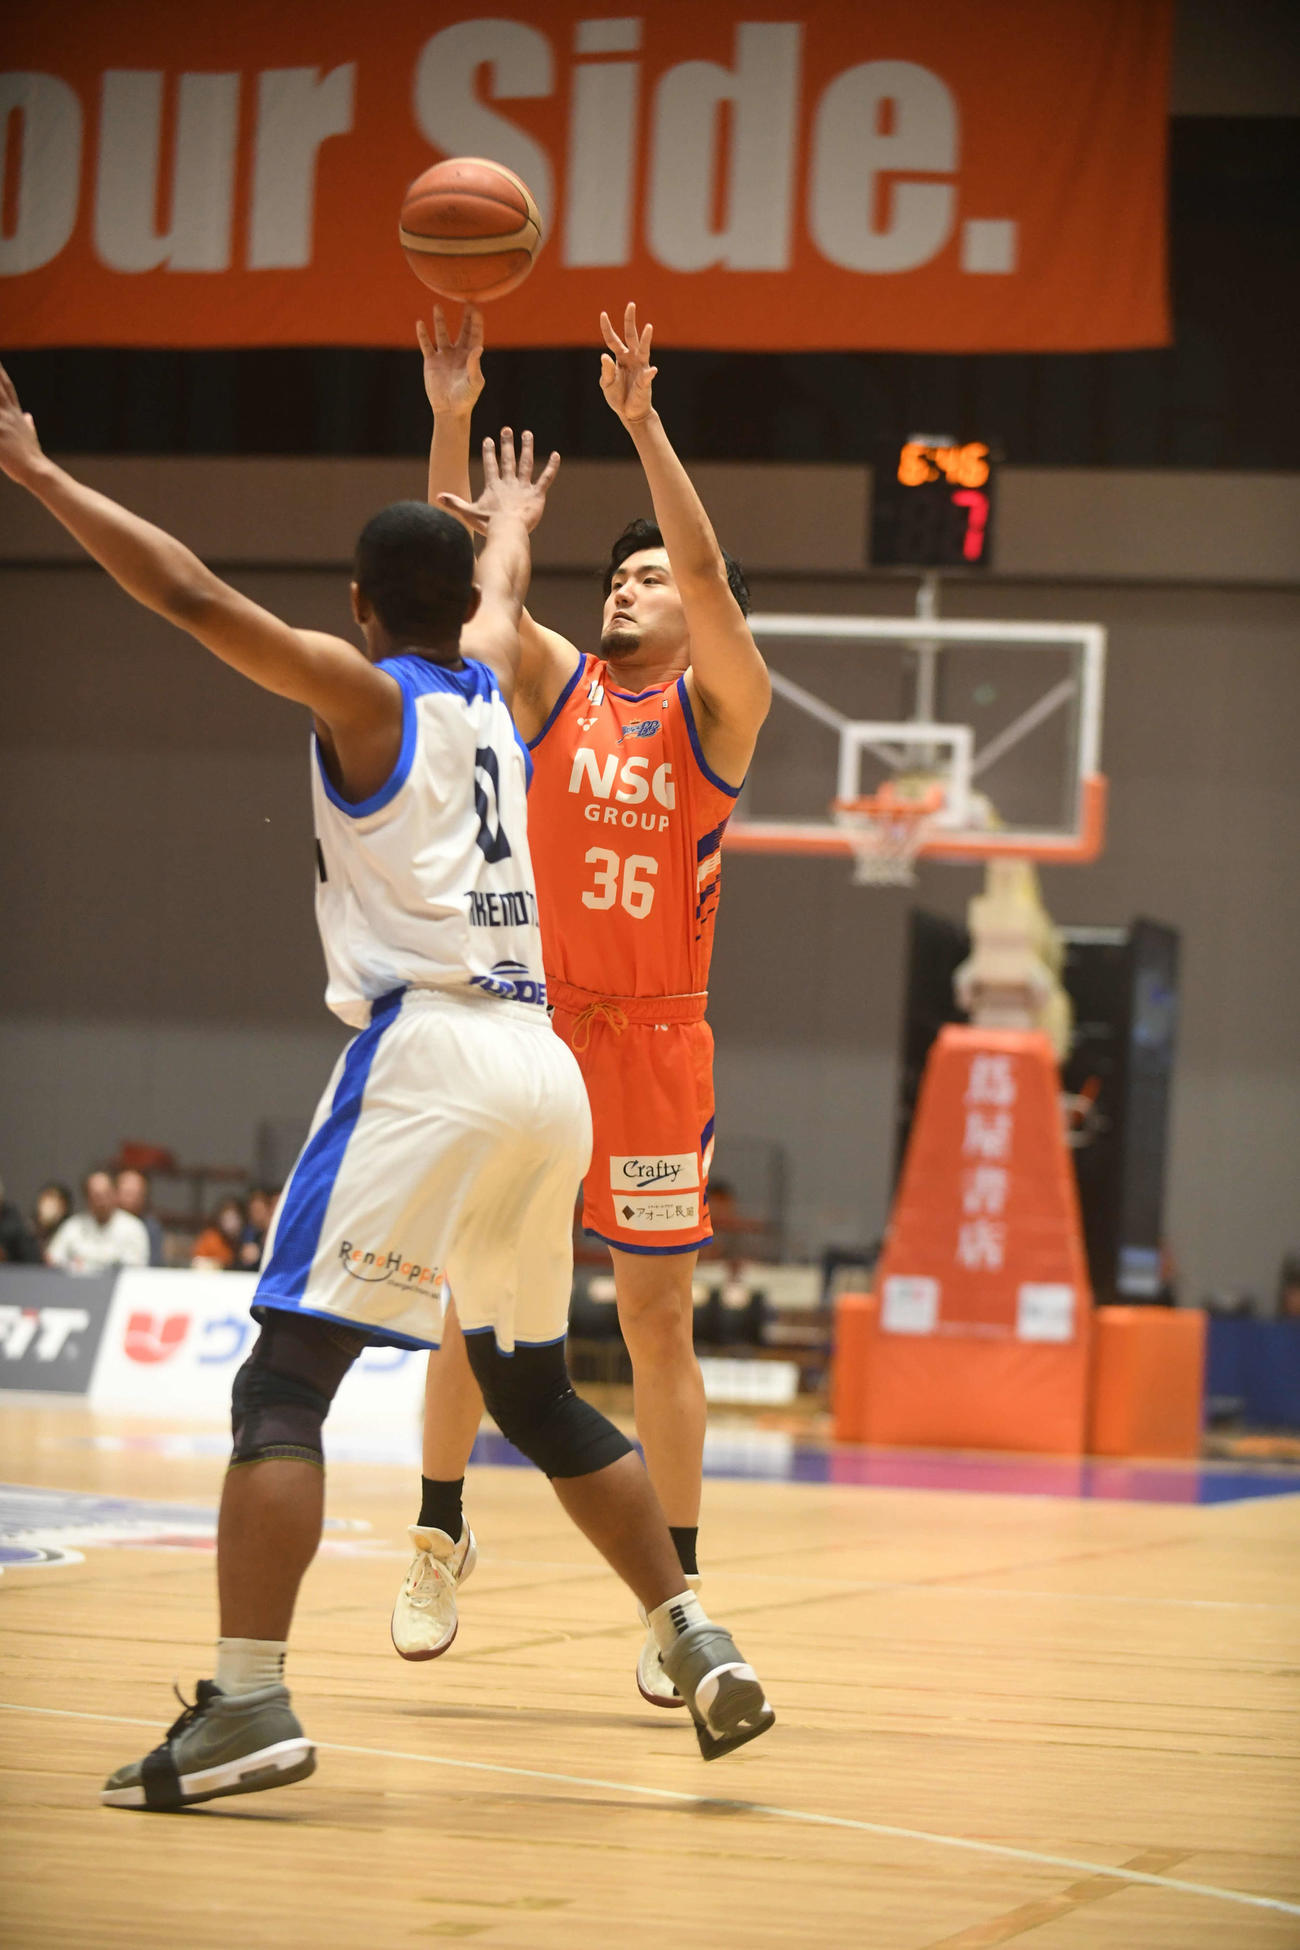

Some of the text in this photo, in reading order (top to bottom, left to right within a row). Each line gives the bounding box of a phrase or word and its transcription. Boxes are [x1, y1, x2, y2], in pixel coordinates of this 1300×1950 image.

[411, 17, 1020, 275] Side.
[951, 490, 989, 562] 7
[475, 745, 512, 864] 0
[568, 747, 676, 810] NSG
[584, 803, 669, 832] GROUP
[581, 846, 659, 920] 36
[623, 1160, 681, 1182] Crafty
